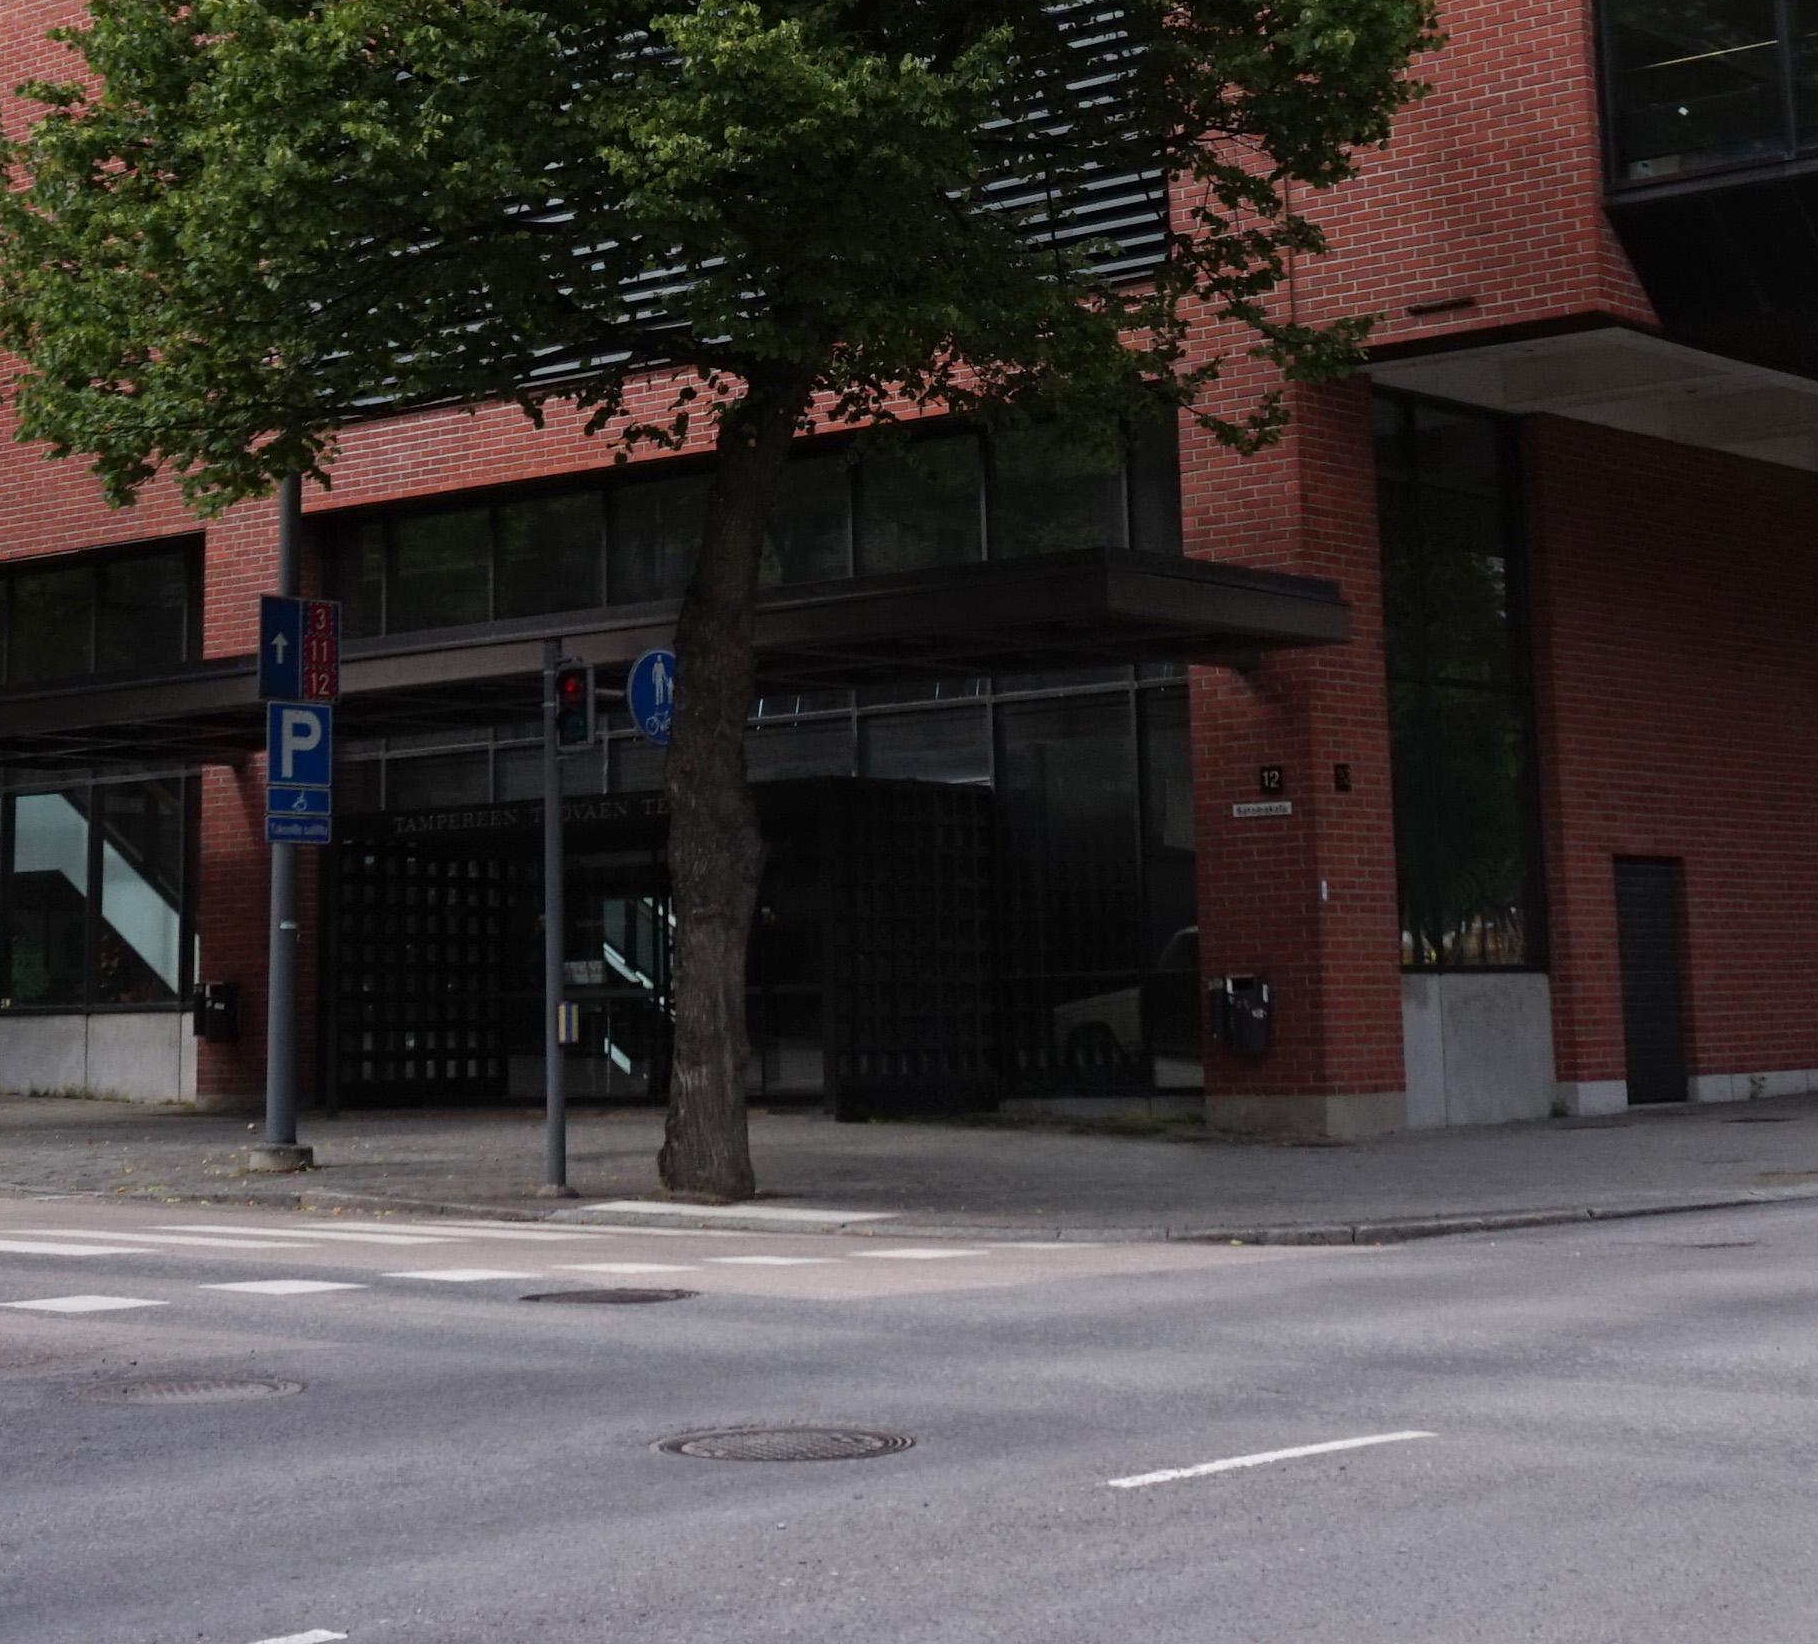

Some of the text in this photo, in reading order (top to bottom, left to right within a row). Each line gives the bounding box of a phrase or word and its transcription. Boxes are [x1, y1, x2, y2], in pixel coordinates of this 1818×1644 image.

[315, 607, 327, 631] 3
[310, 639, 328, 663] 11
[310, 671, 330, 696] 12
[281, 708, 322, 779] P
[1262, 770, 1280, 788] 12
[391, 808, 518, 834] TAMPEREEN
